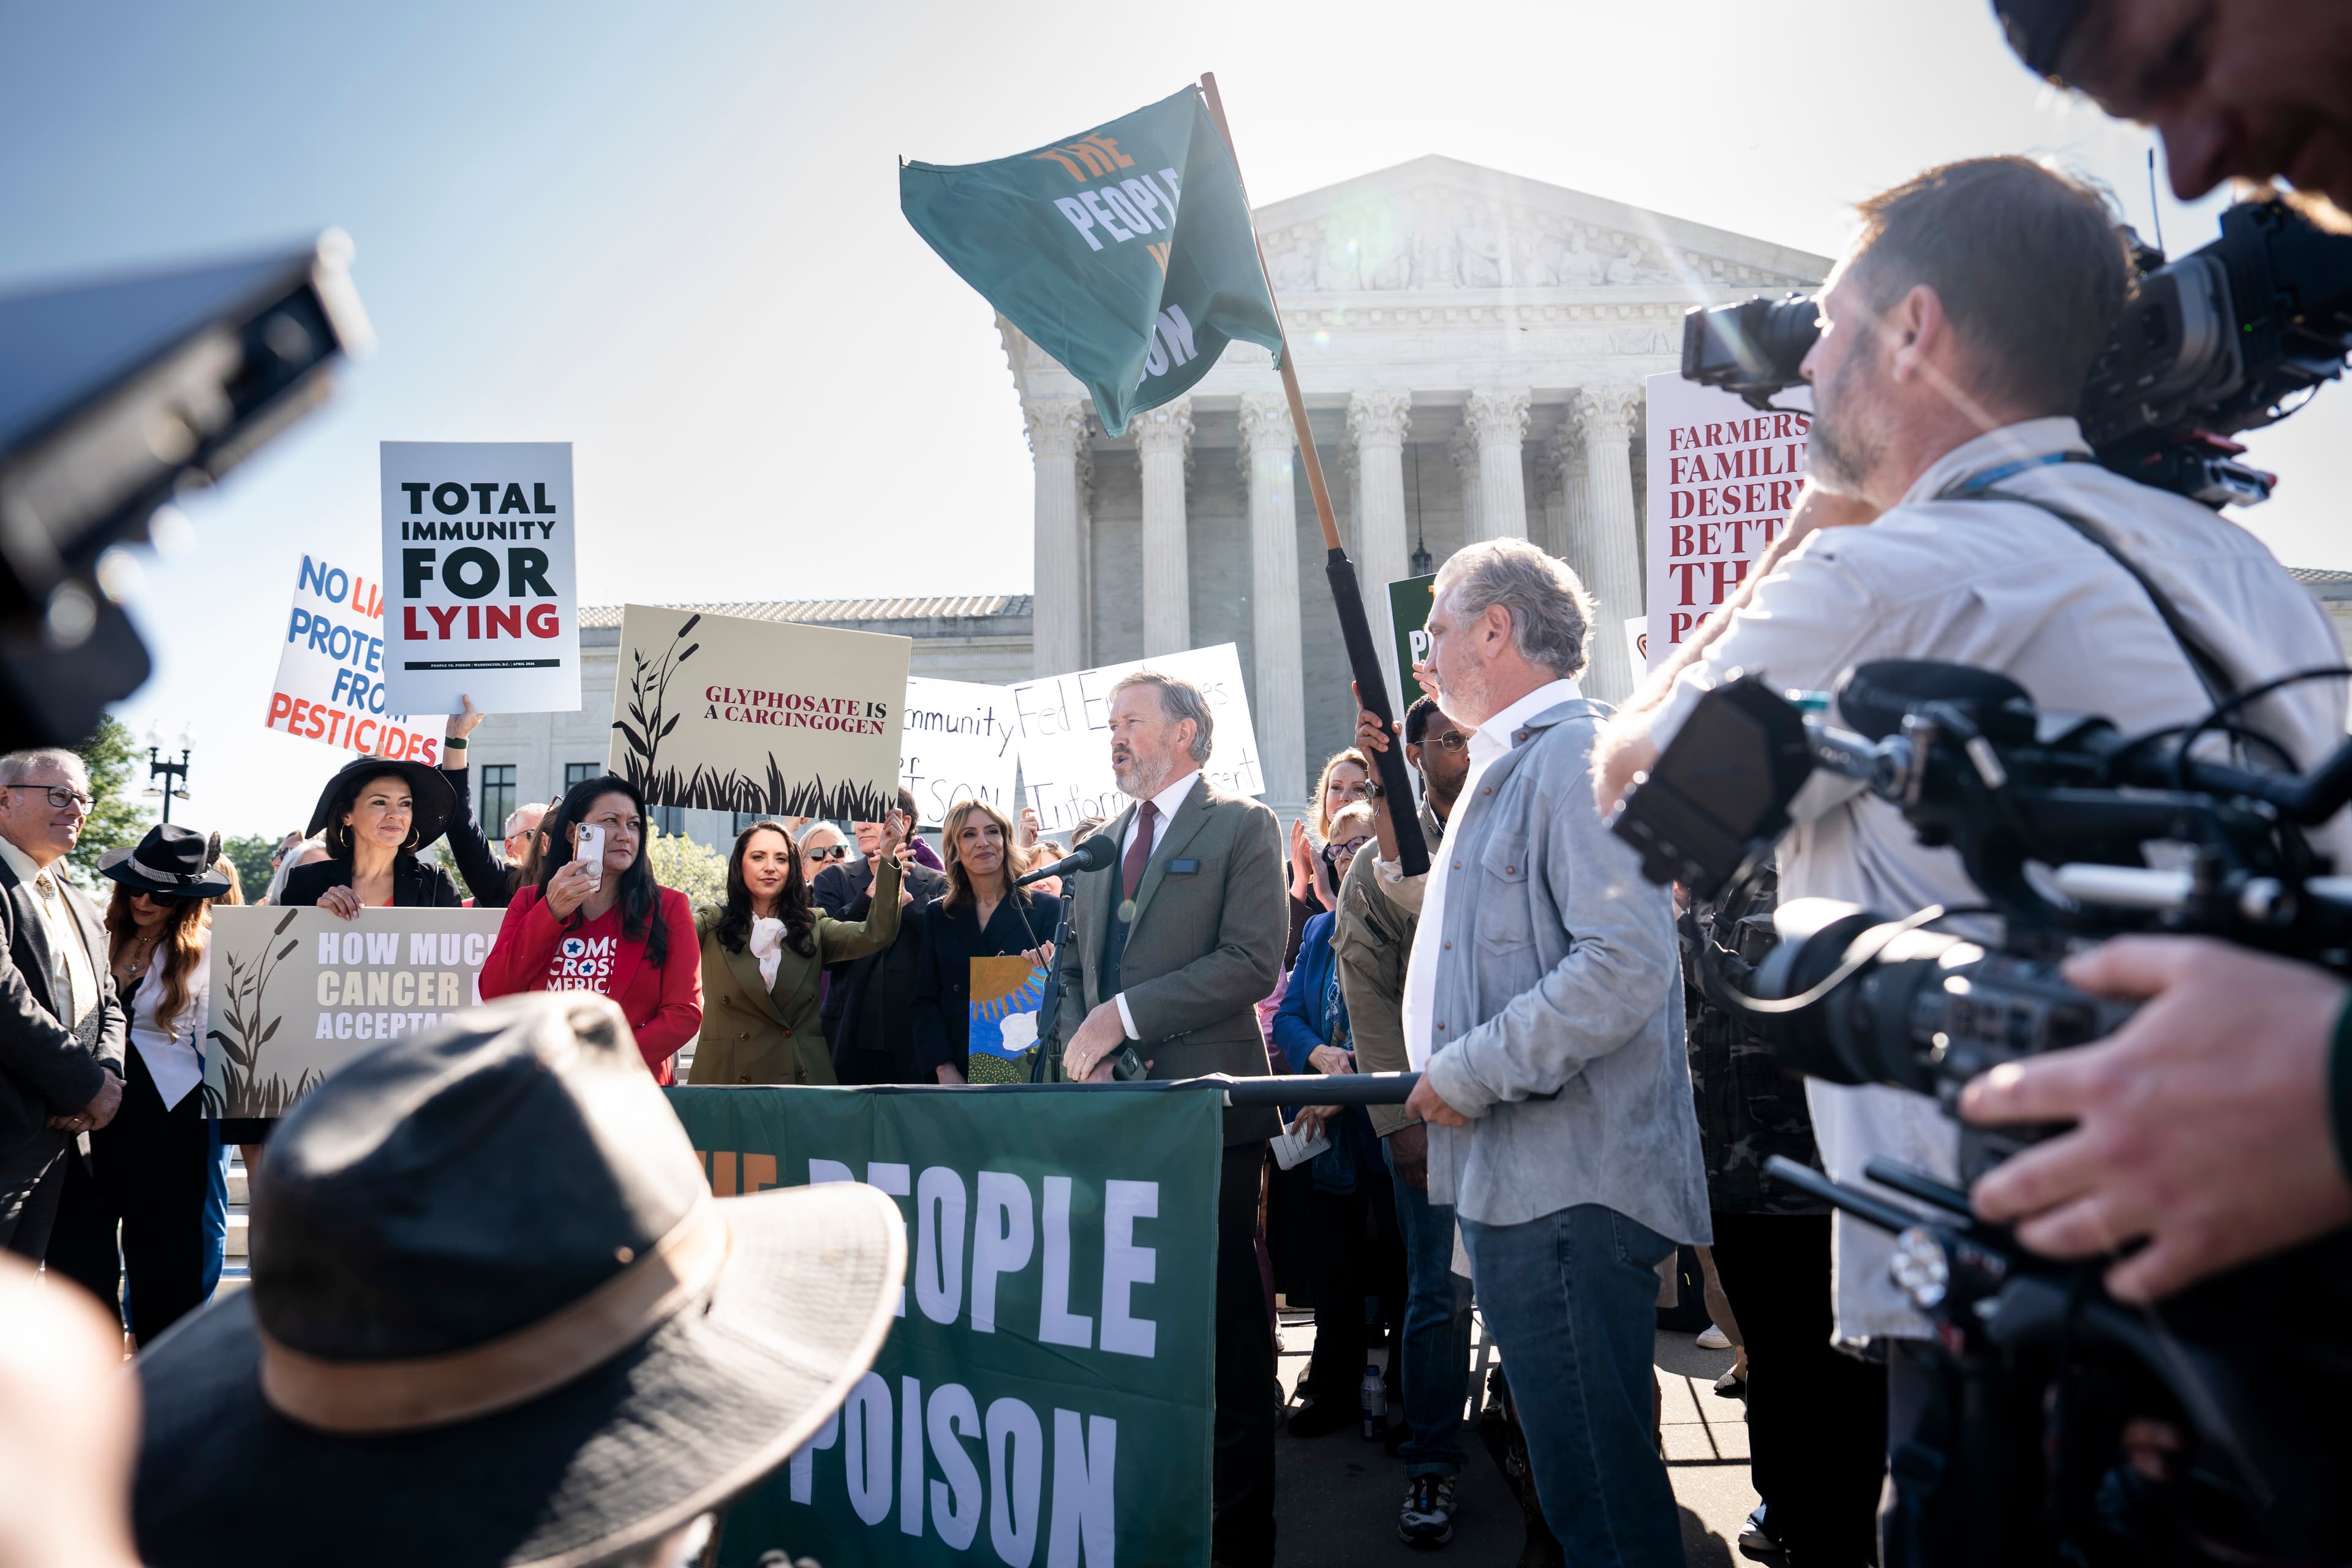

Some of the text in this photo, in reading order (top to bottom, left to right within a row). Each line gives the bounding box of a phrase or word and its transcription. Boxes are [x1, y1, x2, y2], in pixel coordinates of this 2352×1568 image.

[1033, 132, 1136, 183] THE
[1669, 412, 1811, 451] FARMERS
[1669, 442, 1809, 485] FAMILI
[401, 482, 556, 515] TOTAL
[402, 521, 556, 541] IMMUNITY
[1669, 517, 1792, 557] BETT
[299, 555, 349, 603] NO
[402, 546, 558, 600] FOR
[288, 607, 385, 673] PROTE
[404, 603, 560, 640] LYING
[331, 668, 407, 724] FRO
[706, 685, 887, 718] GLYPHOSATE IS
[1014, 679, 1071, 738] Fed
[267, 692, 437, 767] PESTICIDES
[703, 704, 886, 736] A CARCINGOGEN
[903, 682, 1014, 757] mmunity
[318, 932, 399, 965] HOW
[549, 957, 614, 976] CROS
[555, 937, 617, 959] OMS
[317, 970, 459, 1006] CANCER
[546, 978, 611, 994] MERIC
[809, 1158, 1159, 1358] OPLE
